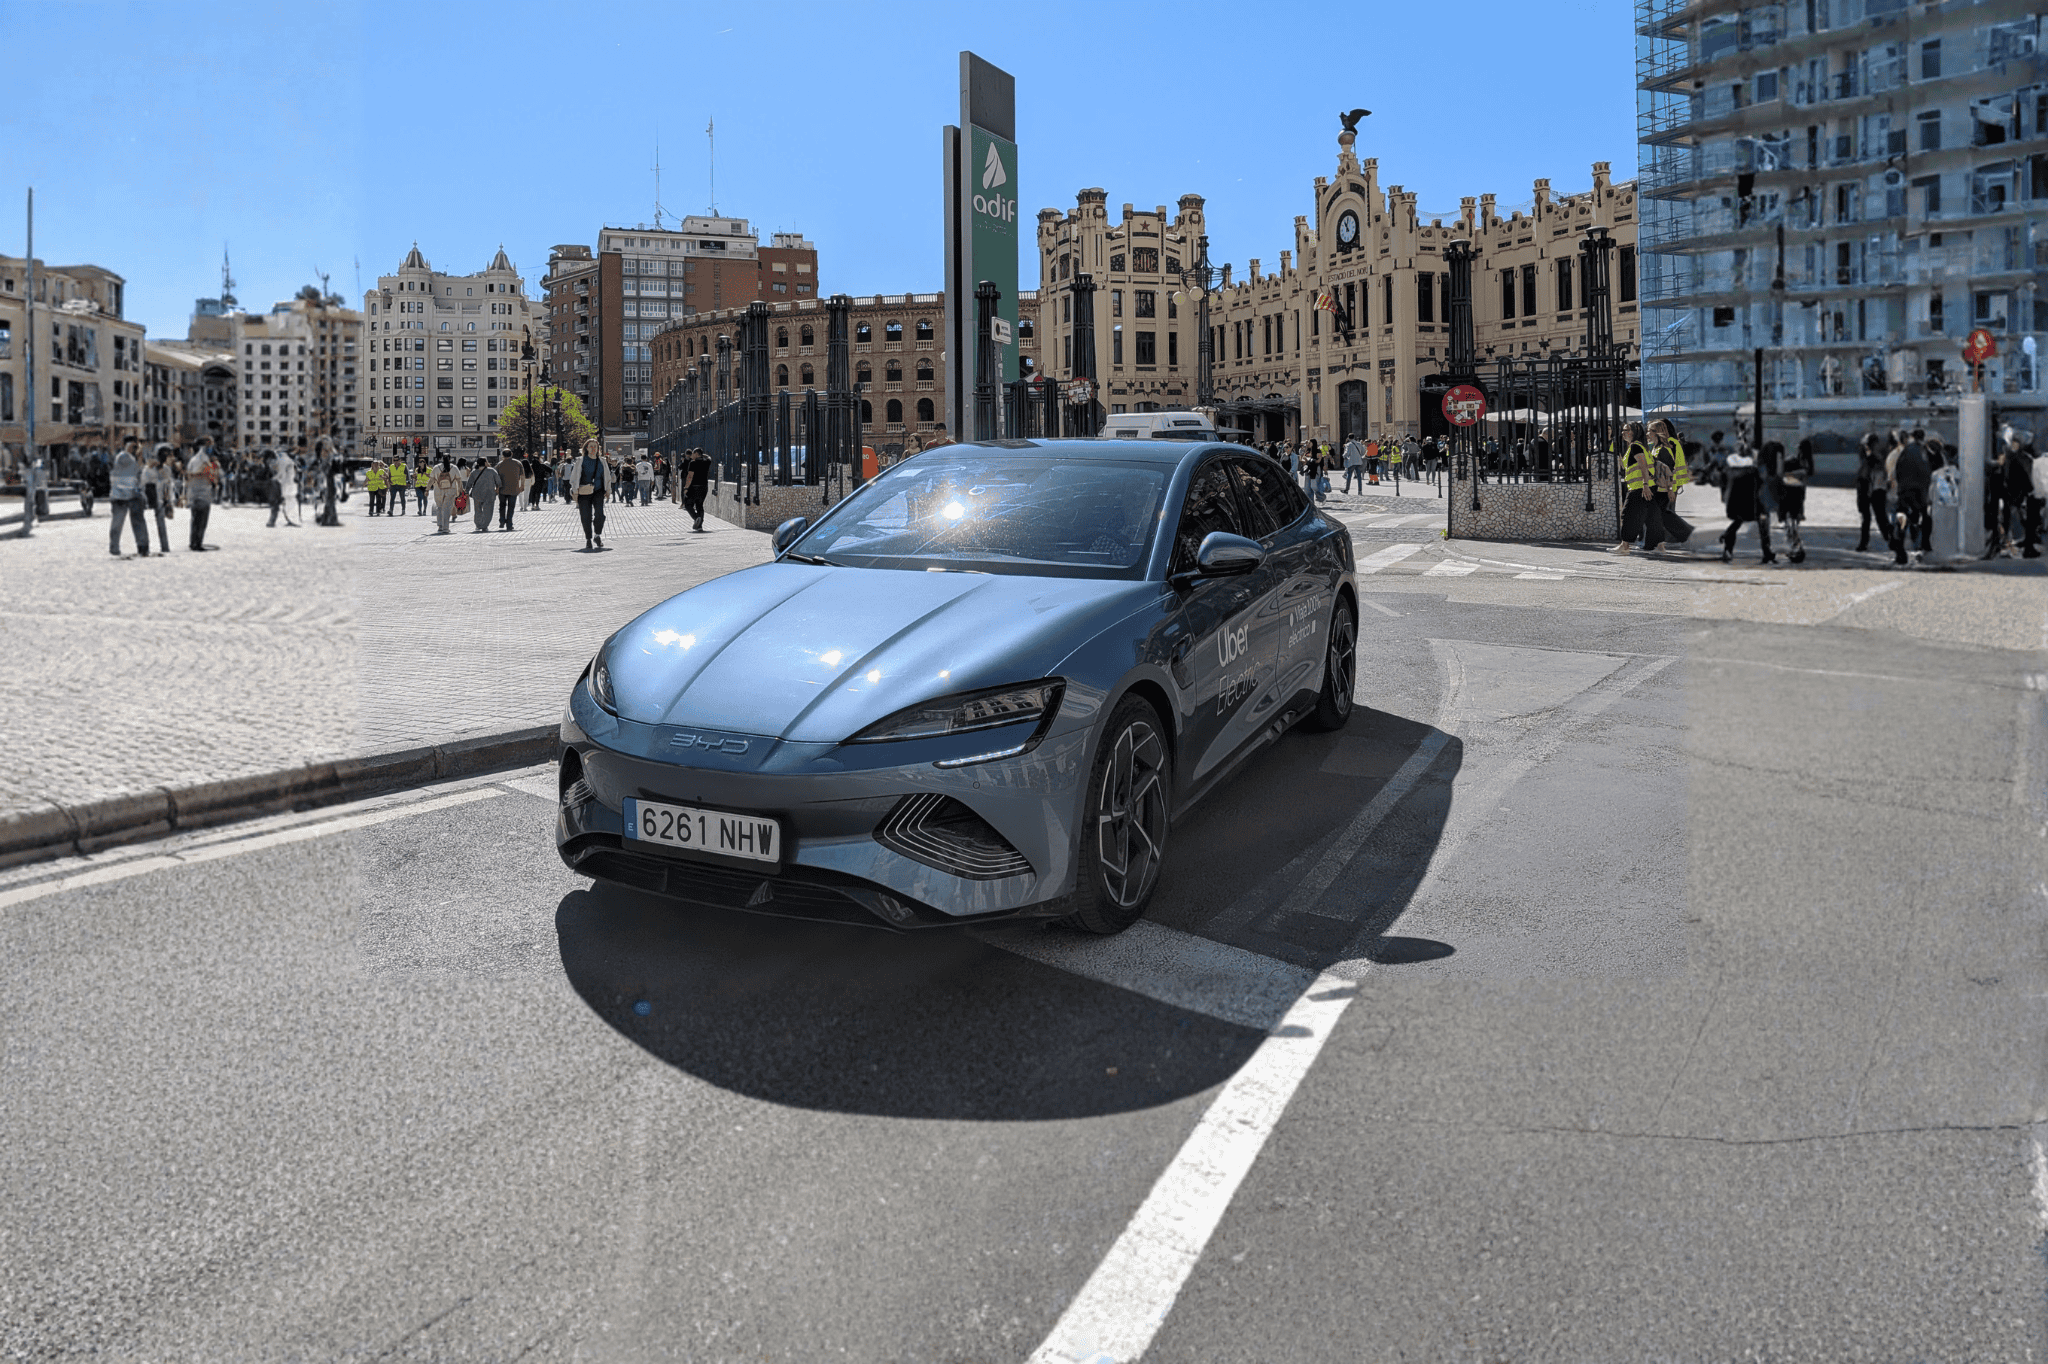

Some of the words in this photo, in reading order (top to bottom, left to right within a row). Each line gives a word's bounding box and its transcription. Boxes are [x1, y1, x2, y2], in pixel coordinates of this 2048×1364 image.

[973, 193, 1016, 223] adif
[1217, 623, 1249, 668] Uber
[1217, 657, 1260, 716] Electric
[669, 732, 751, 754] BYD
[627, 821, 634, 832] E
[642, 807, 707, 846] 6261
[719, 818, 774, 856] NHW
